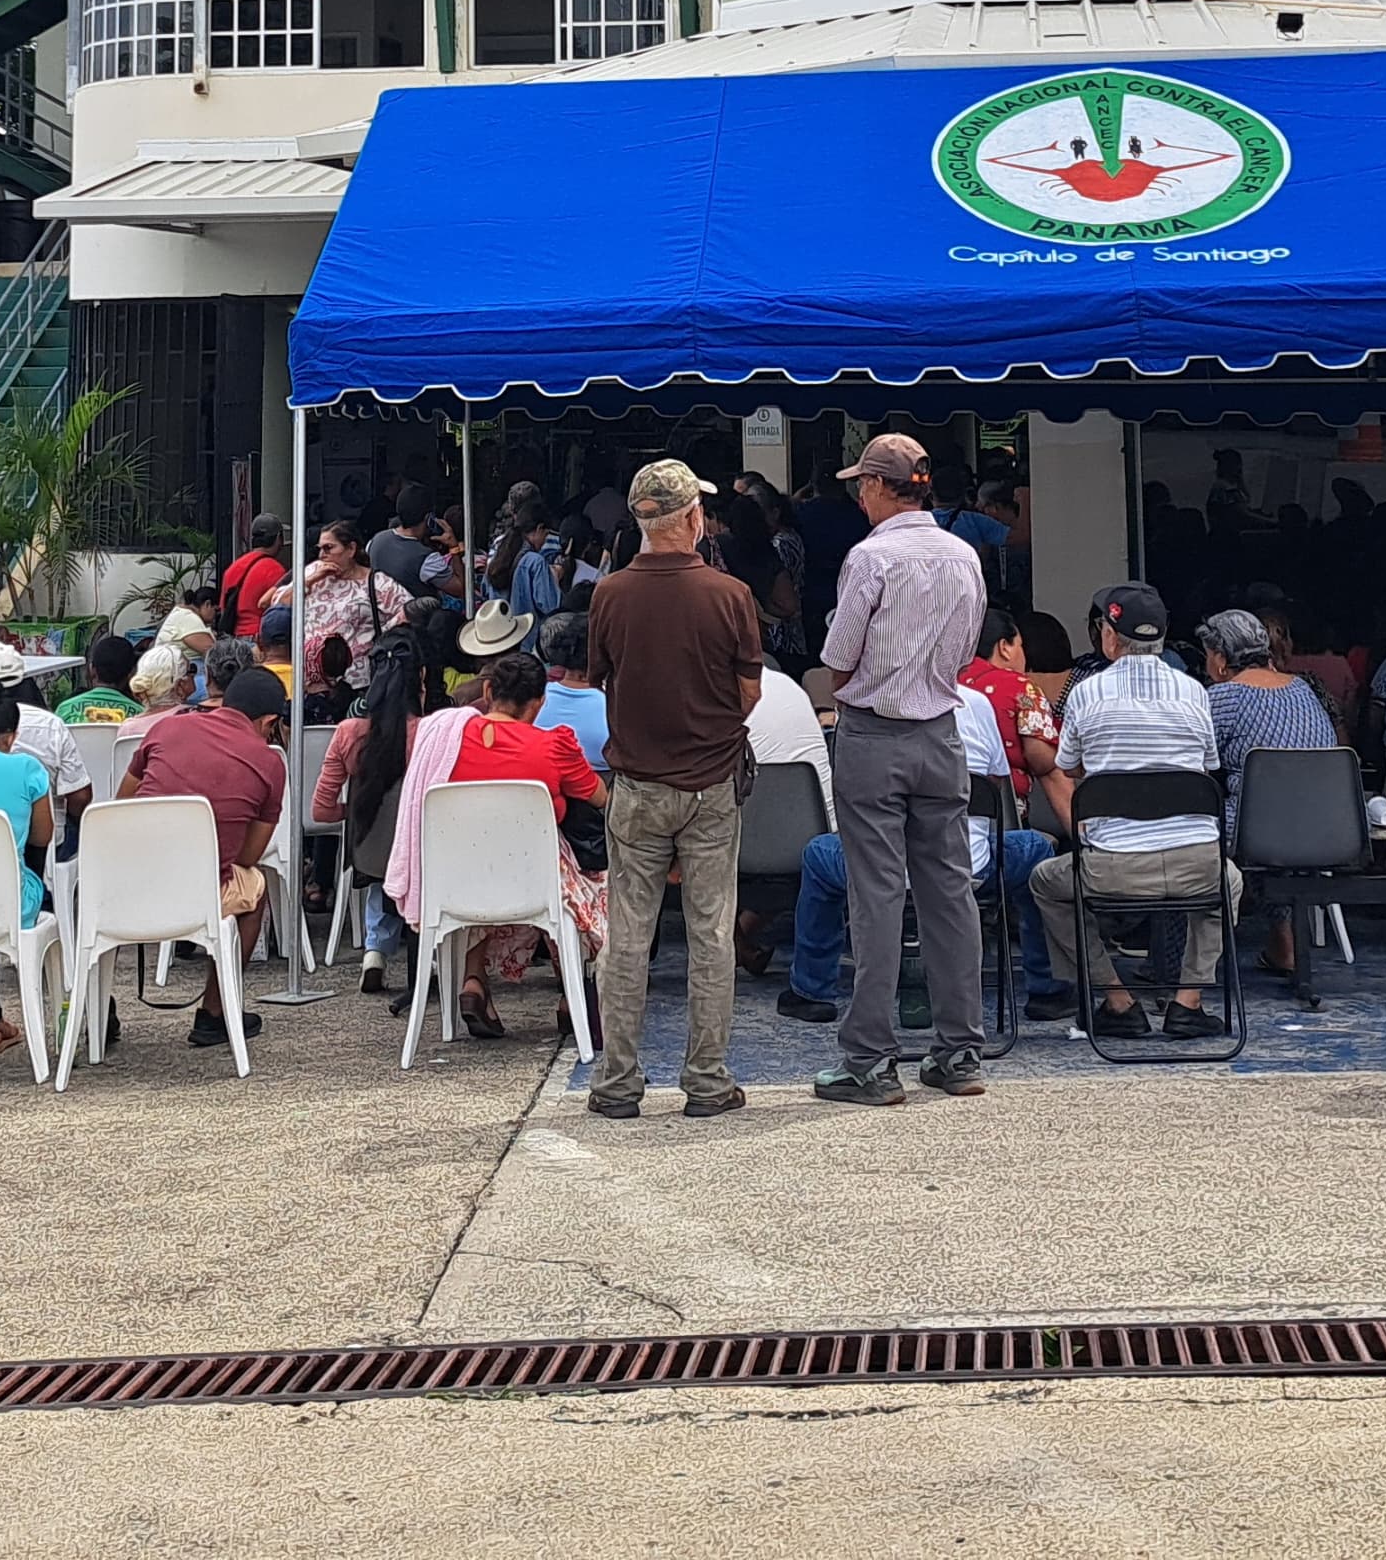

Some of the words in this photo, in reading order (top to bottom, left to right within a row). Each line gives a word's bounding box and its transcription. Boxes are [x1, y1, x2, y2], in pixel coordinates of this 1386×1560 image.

[986, 77, 1118, 118] NACIONAL
[1126, 81, 1230, 121] CONTRA
[1225, 115, 1254, 137] EL
[1028, 218, 1199, 240] PANAMA
[1095, 247, 1136, 262] de
[1153, 246, 1290, 265] Santiago
